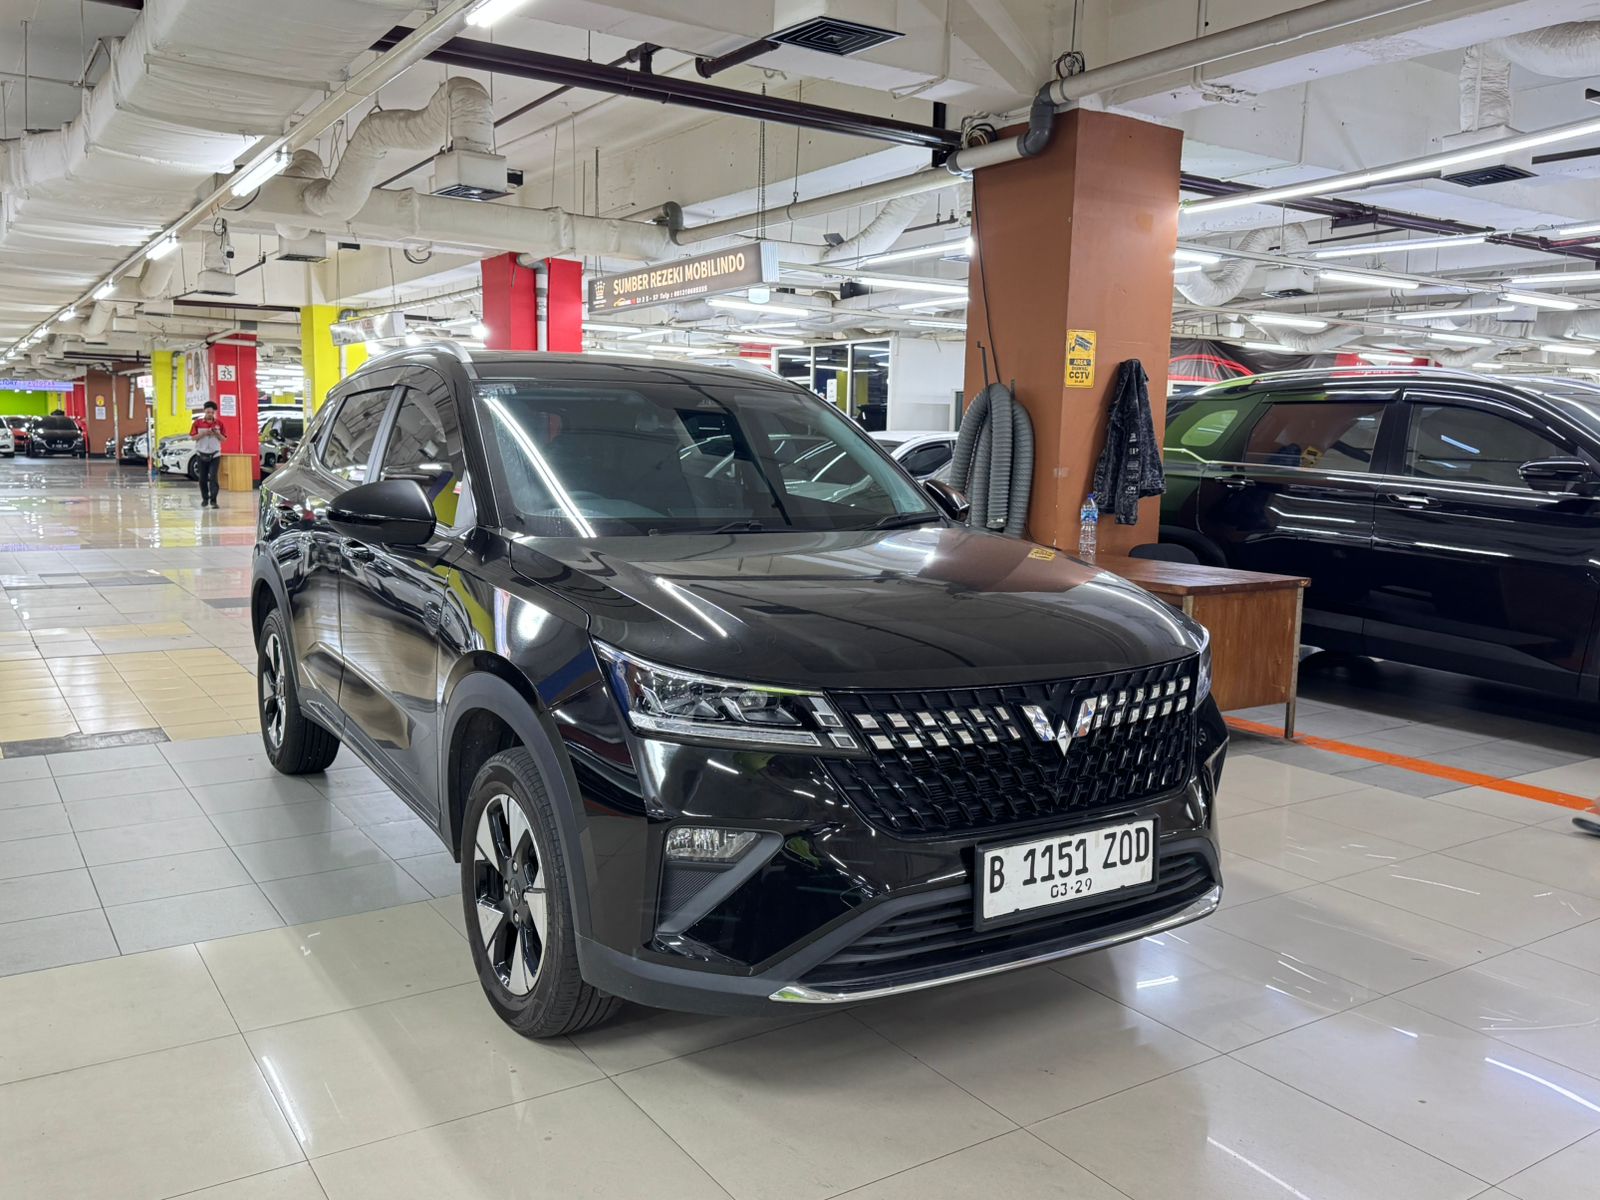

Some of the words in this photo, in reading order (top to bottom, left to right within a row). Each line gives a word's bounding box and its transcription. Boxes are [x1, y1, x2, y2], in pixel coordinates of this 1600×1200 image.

[613, 274, 649, 295] SUMBER
[650, 266, 683, 289] REZEKI
[684, 253, 745, 282] MOBILINDO
[1069, 371, 1090, 379] CCTV
[989, 855, 1005, 894] B
[1022, 838, 1089, 886] 1151
[1102, 826, 1150, 869] ZOD
